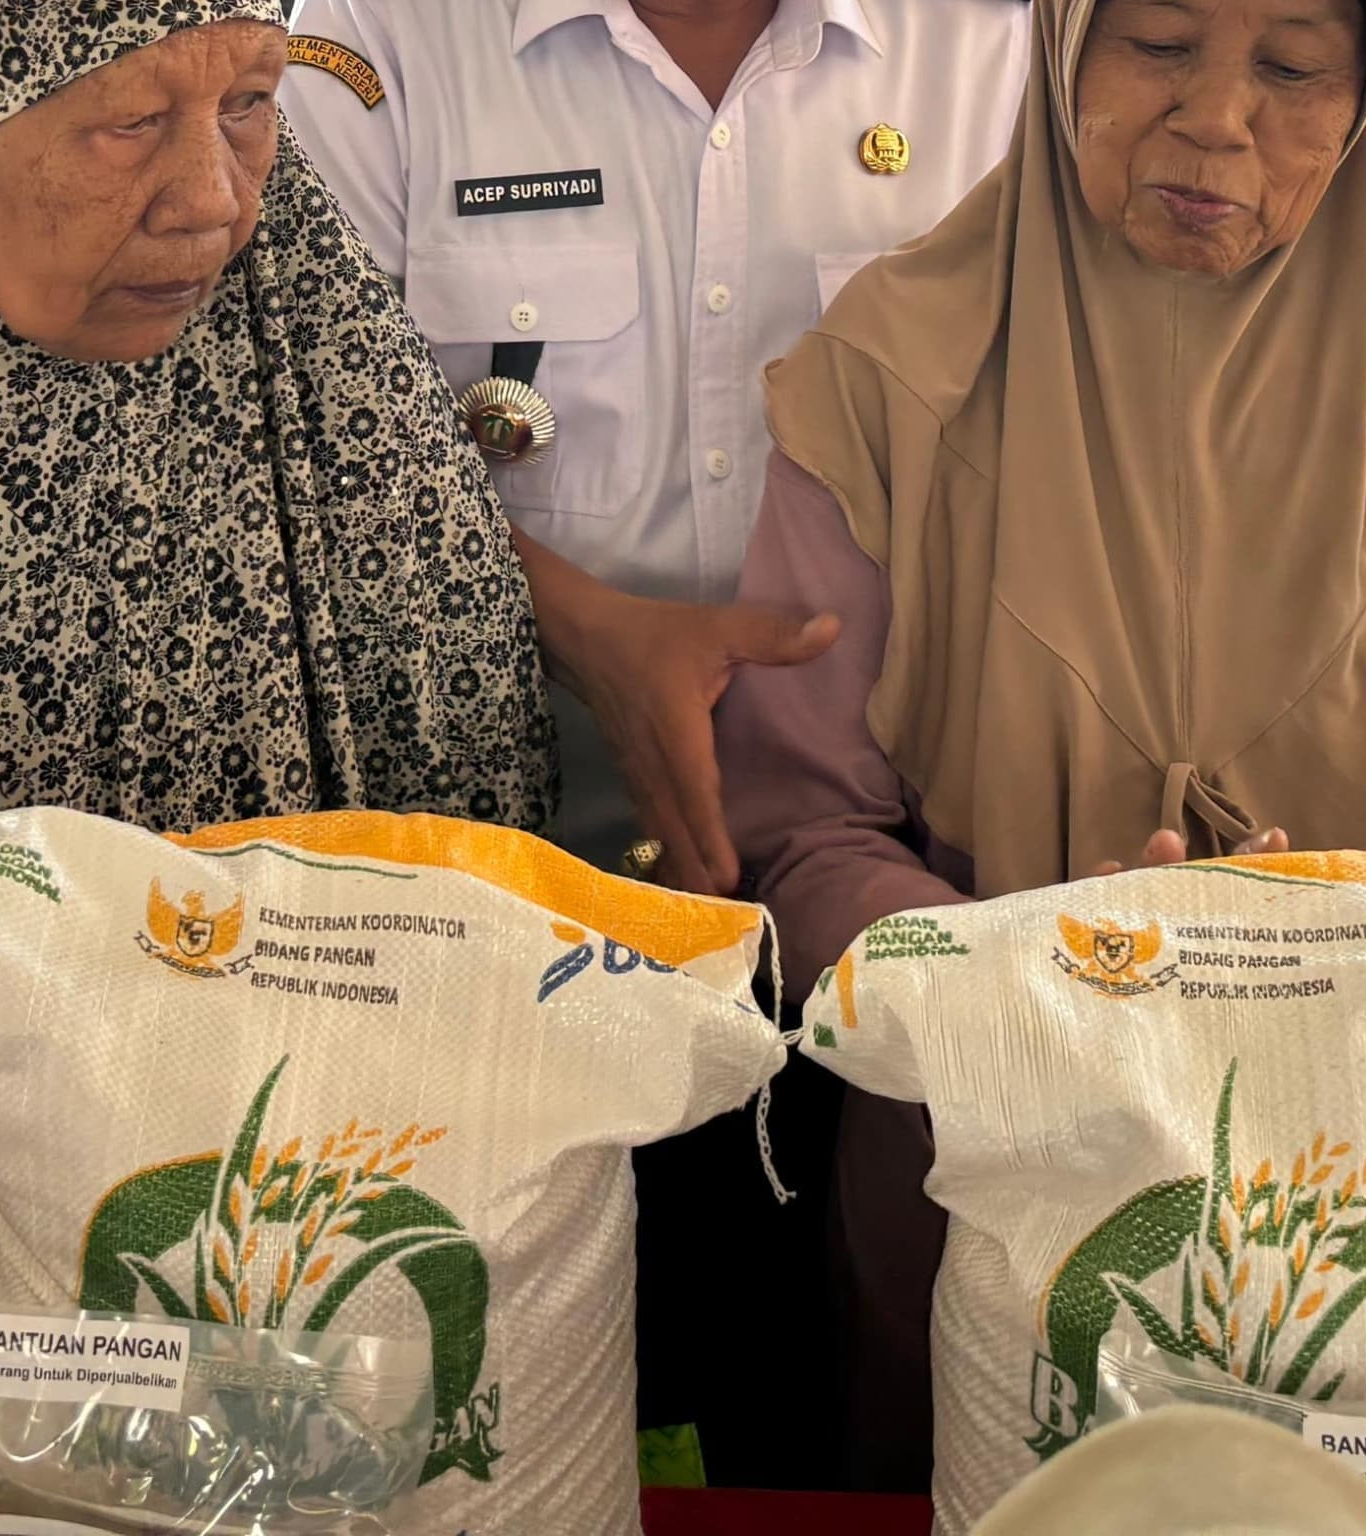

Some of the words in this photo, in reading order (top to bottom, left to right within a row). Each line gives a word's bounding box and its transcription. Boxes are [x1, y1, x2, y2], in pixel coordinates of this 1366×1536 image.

[463, 186, 504, 204] ACEP
[510, 178, 597, 200] SUPRIYADI
[259, 906, 357, 932] KEMENTERIAN
[361, 914, 466, 939] KOORDINATOR
[1176, 926, 1278, 944] KEMENTERIAN
[254, 939, 310, 962] BIDANG
[313, 947, 376, 967] PANGAN
[1179, 949, 1234, 968] BIDANG
[1237, 954, 1301, 969] PANGAN
[251, 971, 318, 996] REPUBLIK
[321, 981, 399, 1006] INDONESIA
[1252, 977, 1335, 1000] INDONESIA
[92, 1336, 182, 1362] PANGAN
[34, 1366, 72, 1382] Untuk
[76, 1368, 177, 1389] Diperjualbelikan
